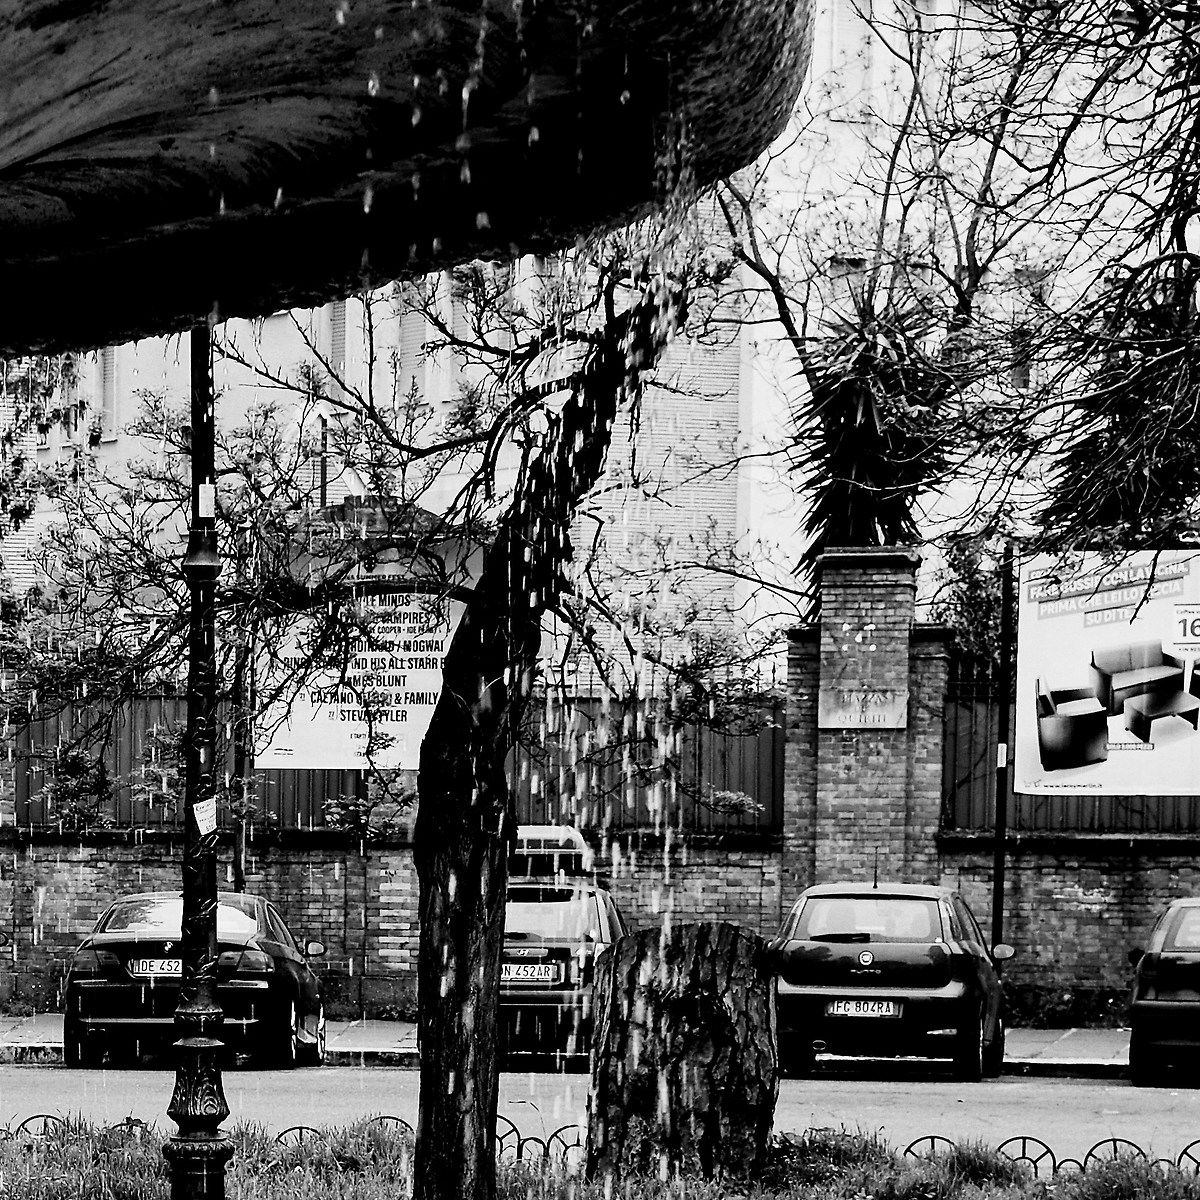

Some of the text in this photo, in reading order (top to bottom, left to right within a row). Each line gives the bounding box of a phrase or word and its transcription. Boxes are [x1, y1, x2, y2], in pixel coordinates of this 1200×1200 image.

[379, 594, 411, 606] MINDS
[1040, 600, 1077, 616] PRIMA
[404, 640, 444, 652] MOGWAI
[370, 658, 387, 670] HIS
[389, 658, 405, 670] ALL
[408, 657, 439, 670] STARR
[346, 675, 408, 687] AMES BLUNT
[404, 692, 440, 705] FAMILY
[141, 960, 181, 972] DE 452
[515, 965, 551, 977] 452AR
[855, 1001, 891, 1013] 804RA
